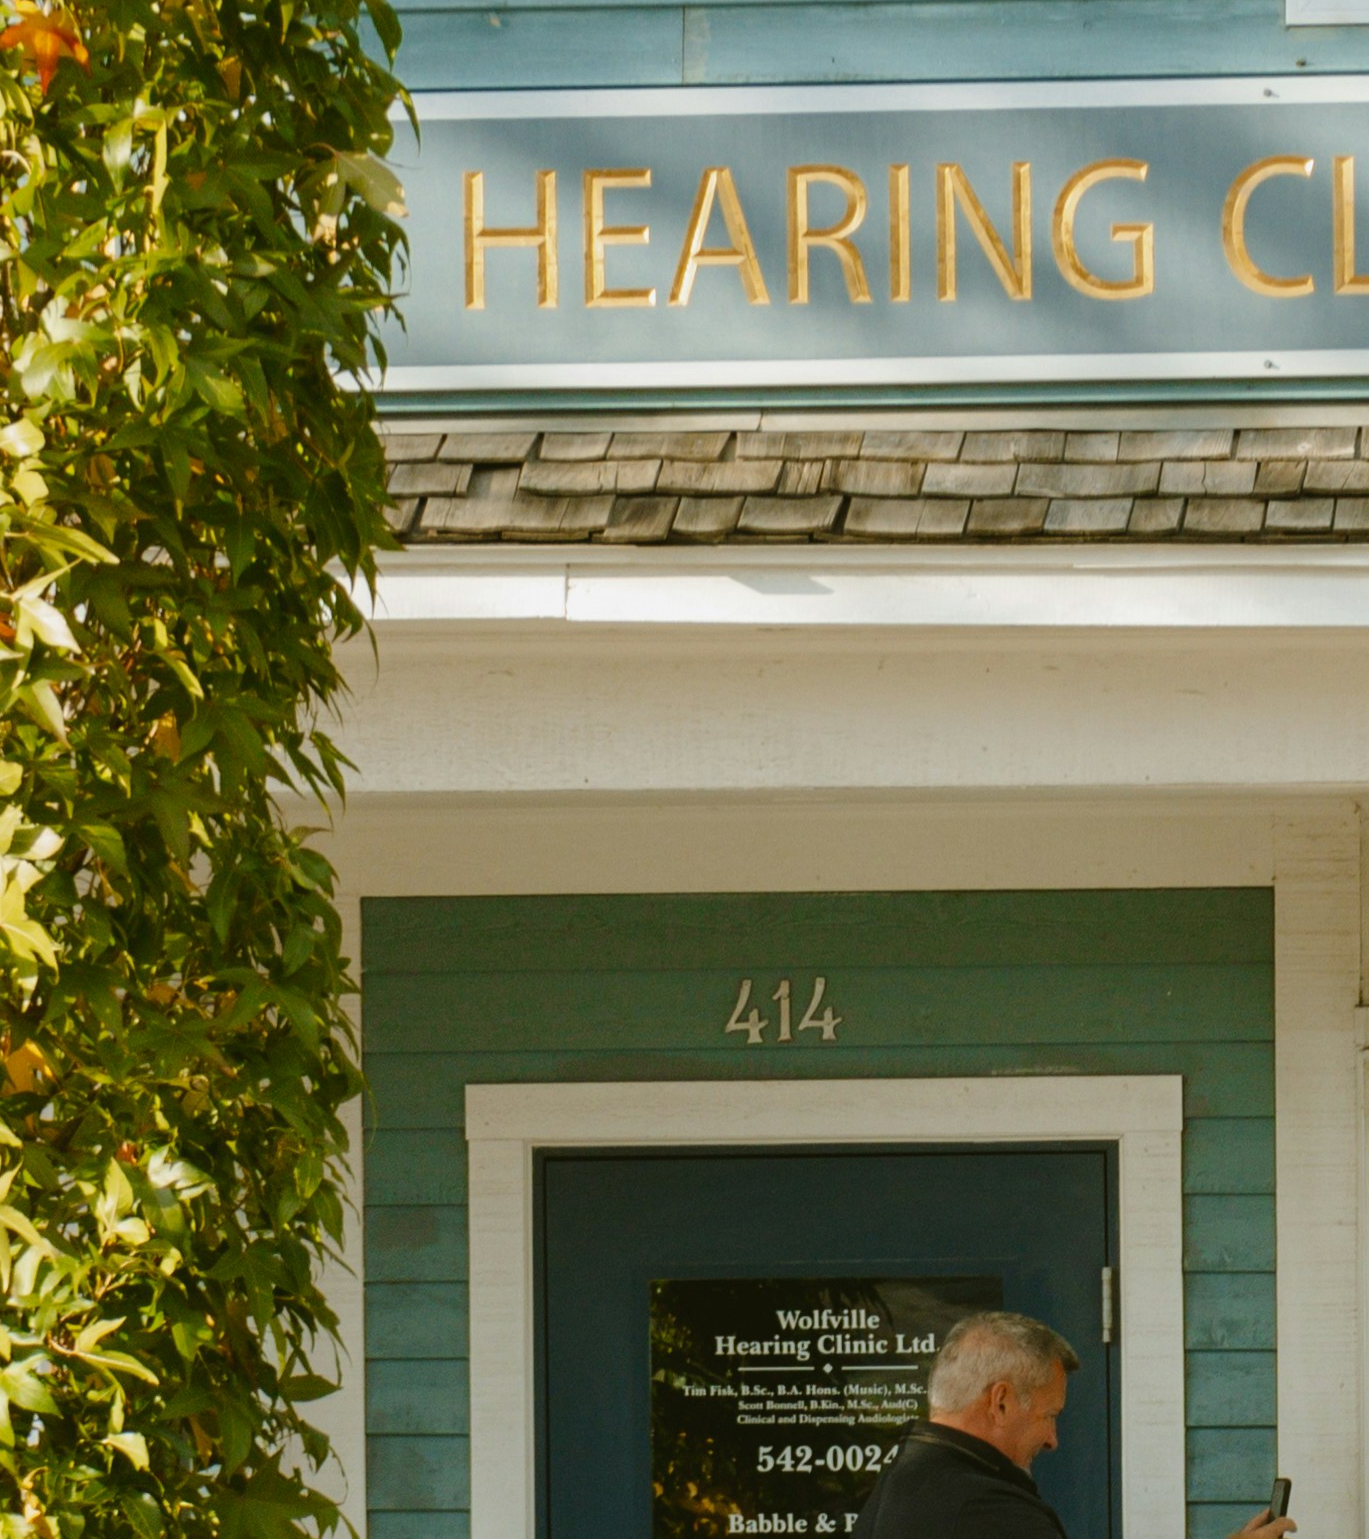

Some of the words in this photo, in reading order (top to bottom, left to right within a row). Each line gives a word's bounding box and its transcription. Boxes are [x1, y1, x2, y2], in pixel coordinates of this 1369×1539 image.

[463, 158, 1154, 310] HEARING
[724, 976, 843, 1045] 414
[777, 1309, 880, 1329] Wolfville
[716, 1335, 810, 1360] Hearing
[818, 1334, 887, 1354] Clinic
[683, 1385, 706, 1396] Tim
[778, 1414, 796, 1423] and
[858, 1413, 919, 1425] Audiologi
[728, 1513, 808, 1533] Babble
[815, 1514, 835, 1533] &
